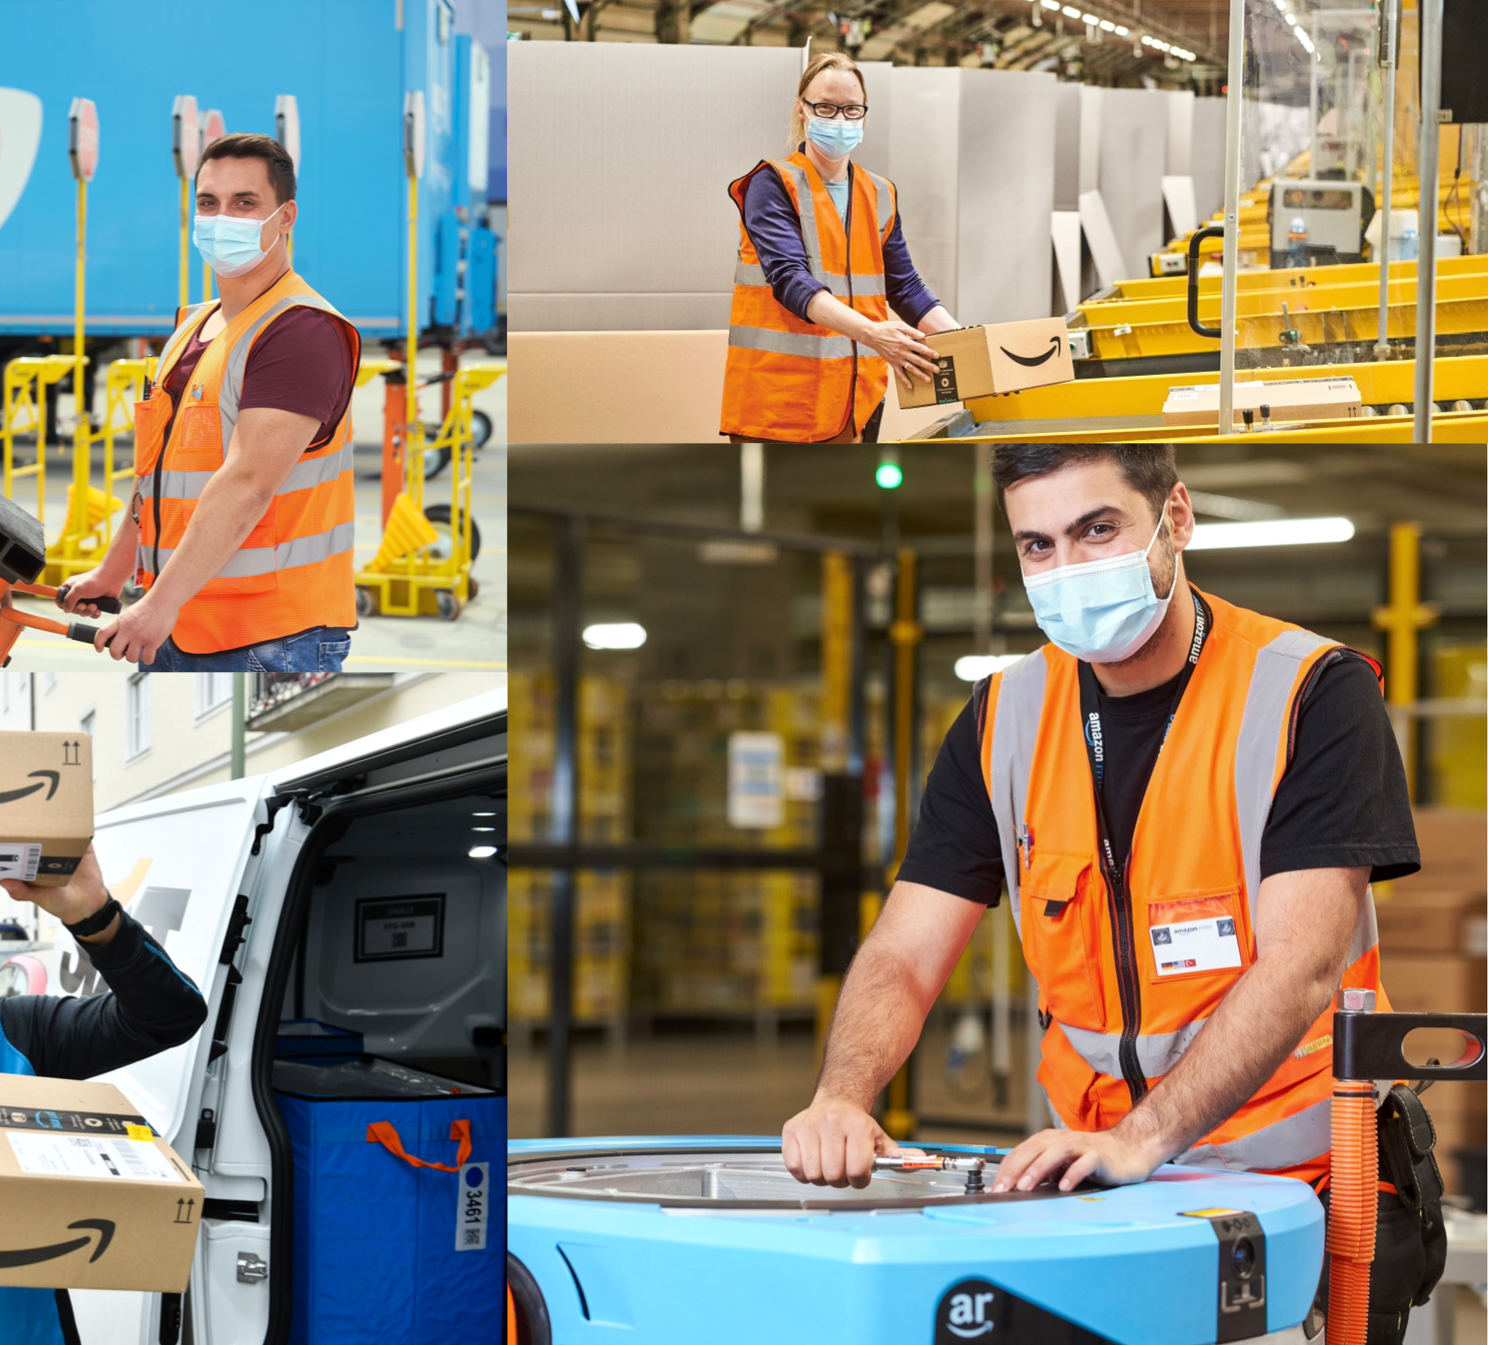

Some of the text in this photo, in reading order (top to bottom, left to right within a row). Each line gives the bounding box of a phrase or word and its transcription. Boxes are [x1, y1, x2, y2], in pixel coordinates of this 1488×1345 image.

[1188, 615, 1205, 665] amazon
[1088, 711, 1105, 762] amazon
[1173, 926, 1199, 935] amazon
[464, 1190, 483, 1224] 3461
[948, 1292, 995, 1326] ar
